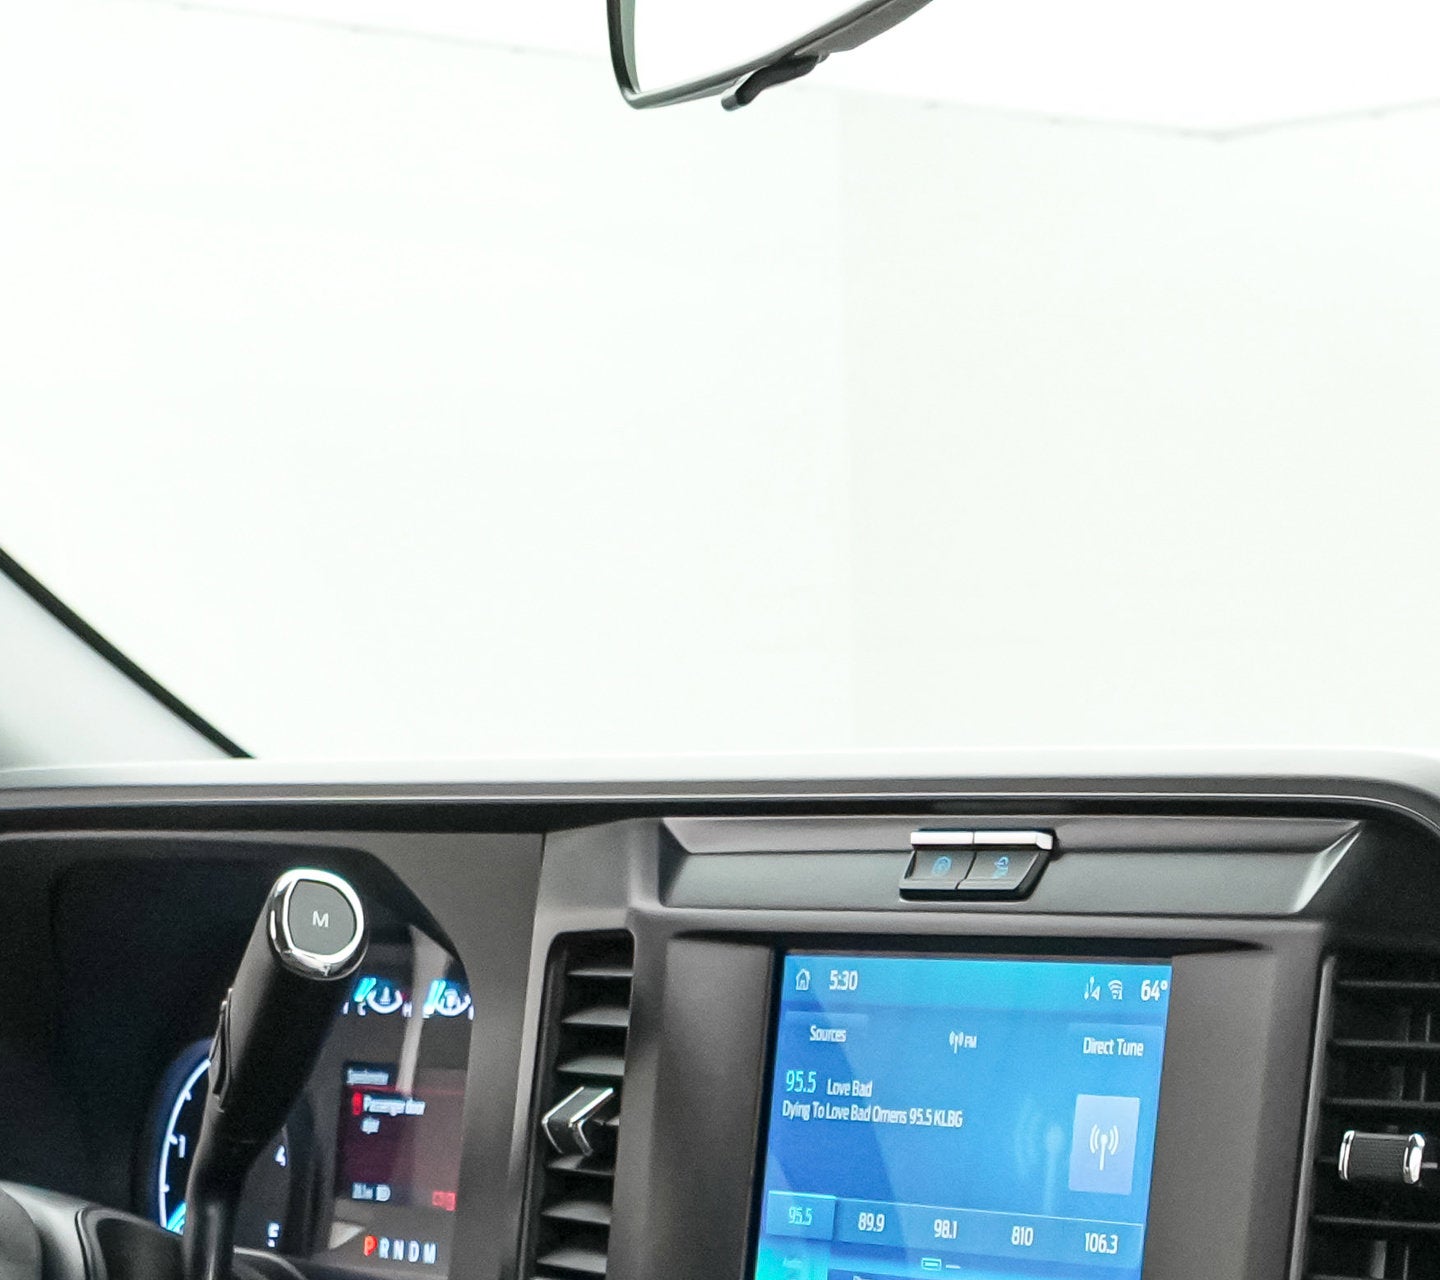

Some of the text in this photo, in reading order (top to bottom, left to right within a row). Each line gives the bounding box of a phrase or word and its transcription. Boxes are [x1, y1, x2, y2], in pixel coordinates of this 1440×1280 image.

[312, 911, 329, 928] M
[828, 969, 859, 991] 5:30
[809, 1024, 847, 1043] Sources
[963, 1035, 978, 1049] FM
[1082, 1036, 1145, 1058] Direct Tune
[785, 1069, 873, 1098] 95.5 Love Bad
[782, 1099, 810, 1122] Dying
[812, 1100, 825, 1119] To
[825, 1101, 850, 1121] Love
[850, 1104, 871, 1122] Bad
[872, 1105, 908, 1125] Omens
[908, 1107, 933, 1127] 95.5
[787, 1206, 813, 1226] 95.5
[857, 1211, 886, 1233] 89.9
[932, 1218, 958, 1240] 98.1
[1010, 1225, 1035, 1247] 810
[1084, 1231, 1119, 1255] 106.3
